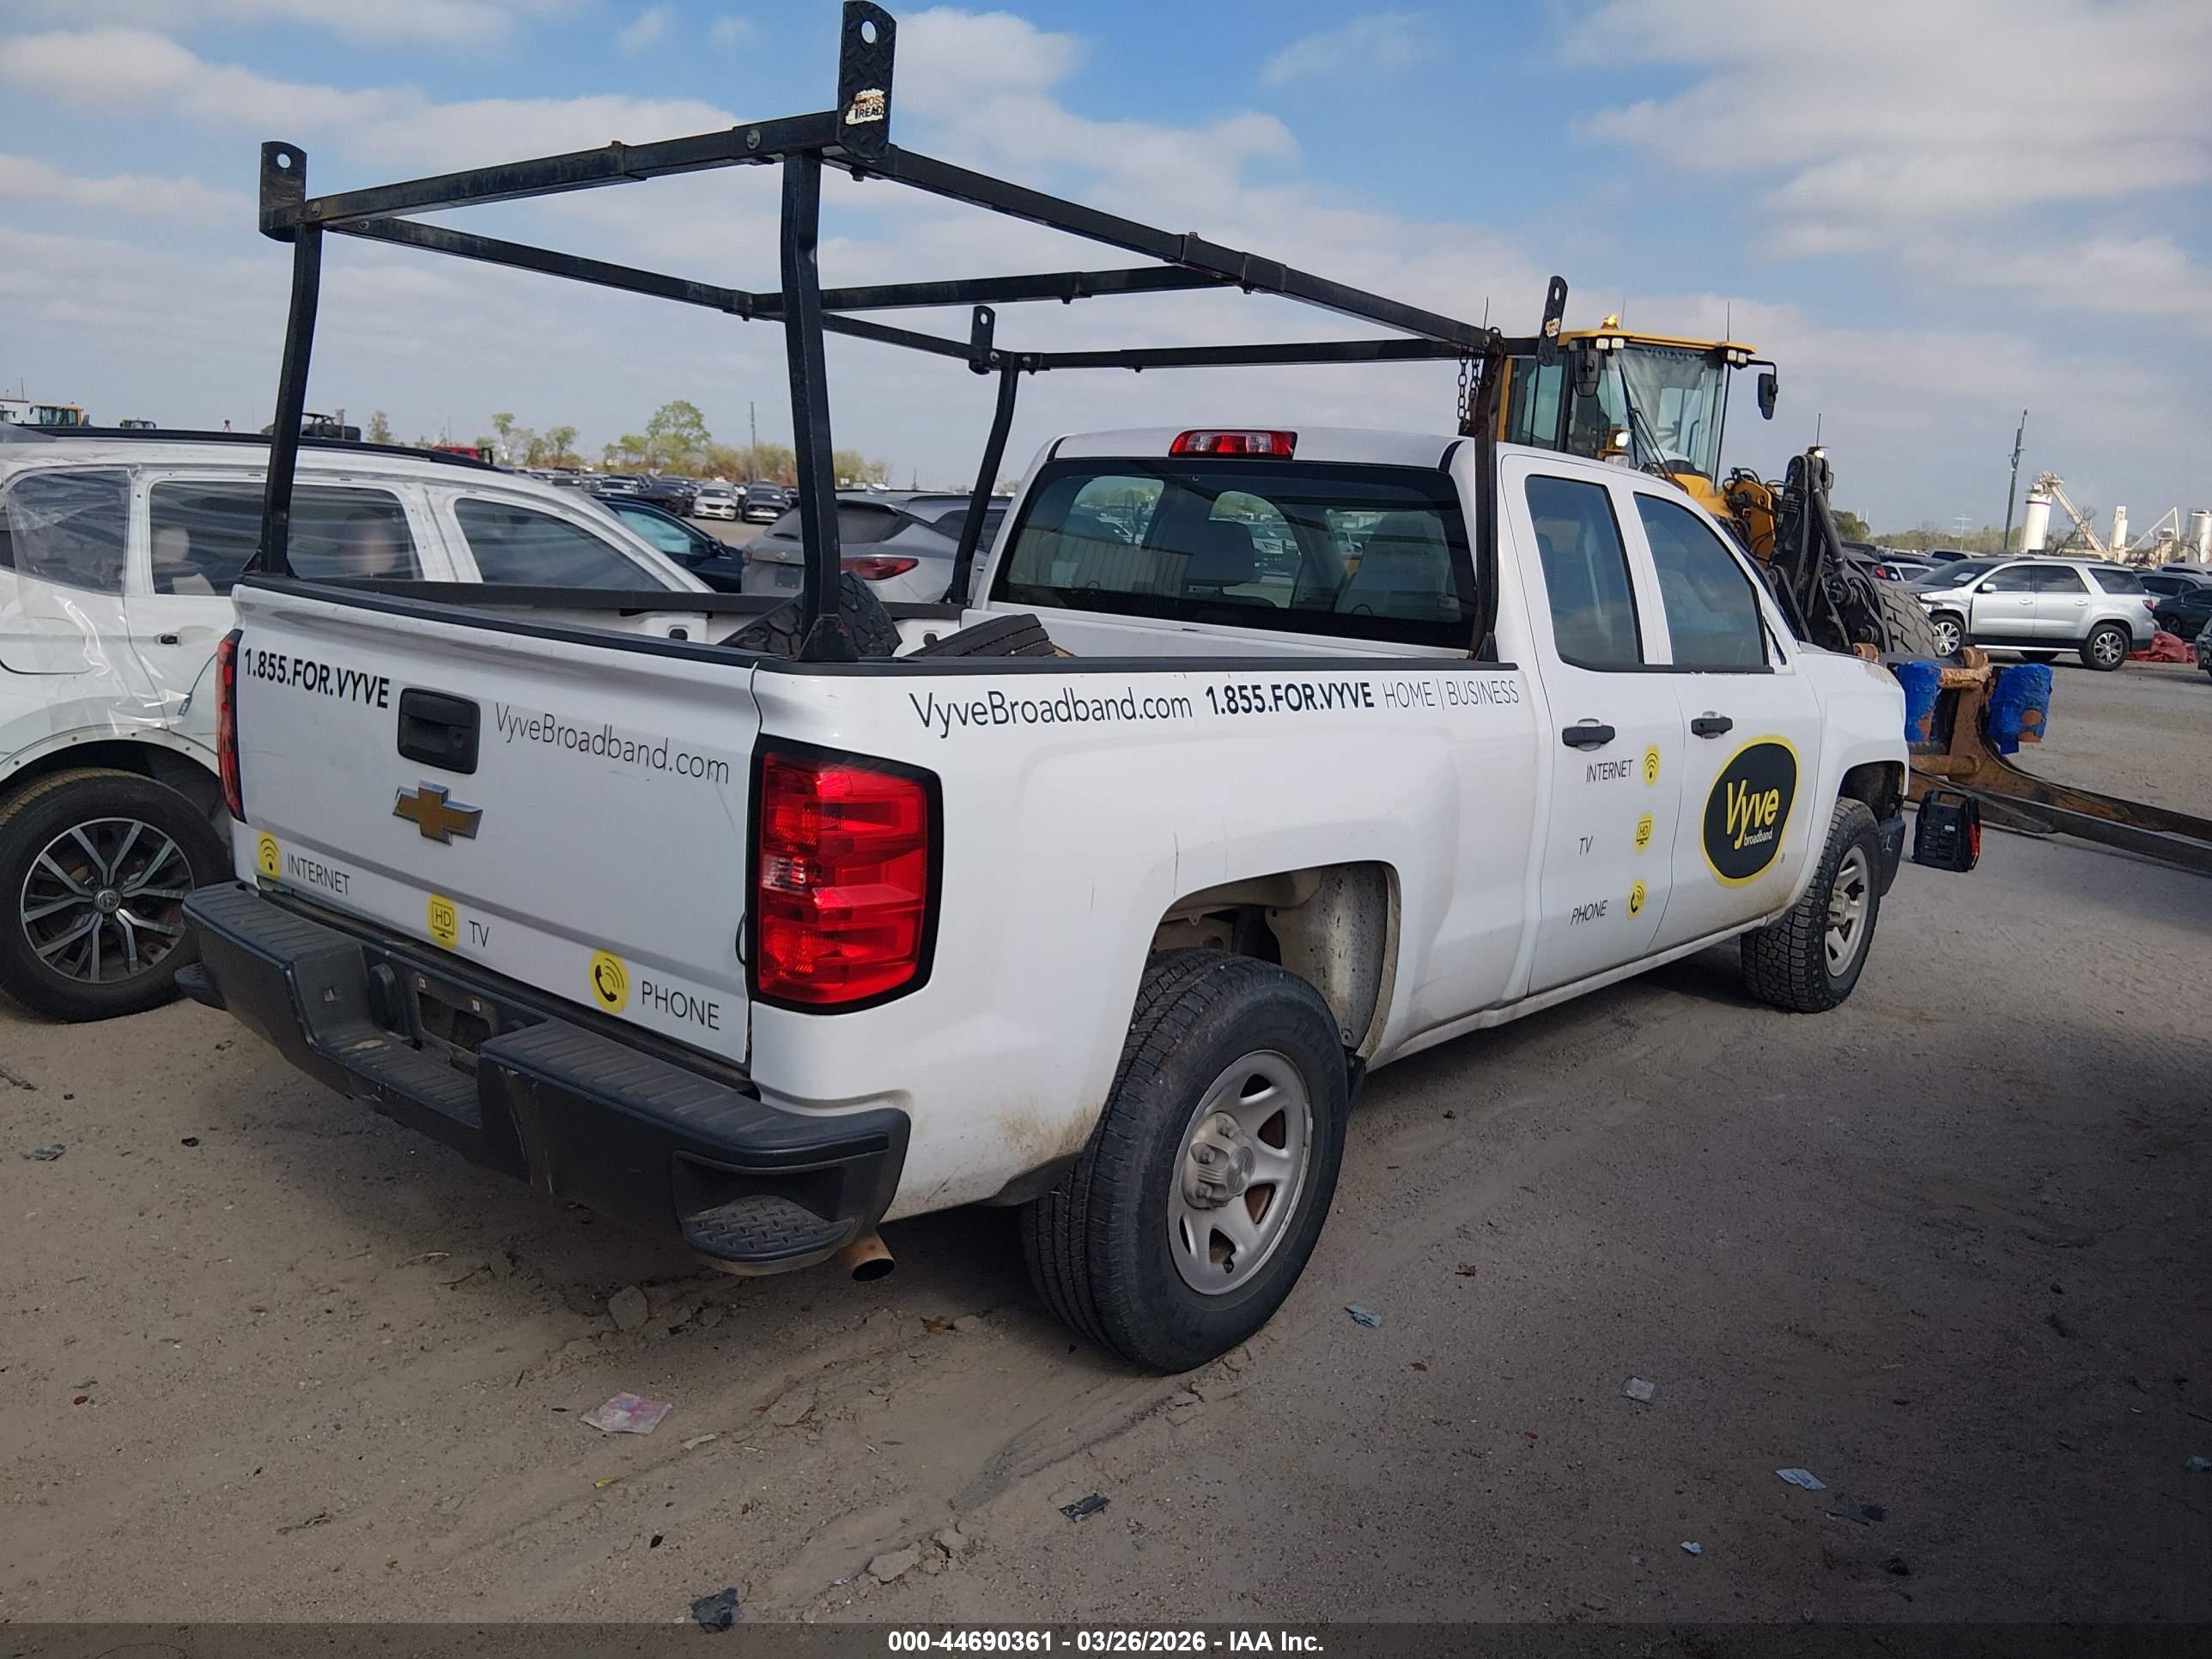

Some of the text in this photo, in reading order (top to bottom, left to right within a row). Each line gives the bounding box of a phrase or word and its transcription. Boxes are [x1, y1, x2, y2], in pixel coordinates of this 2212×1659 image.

[244, 647, 390, 708] 1.855.FOR.VYVE
[908, 687, 1193, 738] VyveBroadband.com
[1206, 682, 1375, 714] 1.855.FOR.VYVE
[1382, 681, 1436, 708] HOME
[1447, 680, 1520, 706] BUSINESS
[495, 702, 730, 784] VyveBroadband.com
[1586, 759, 1633, 783] INTERNET
[1726, 779, 1779, 850] Vyve
[1579, 836, 1593, 855] TV
[1743, 829, 1773, 848] broadband
[286, 853, 350, 895] INTERNET
[434, 908, 453, 929] HD
[1570, 899, 1608, 926] PHONE
[469, 920, 489, 947] TV
[641, 980, 720, 1030] PHONE
